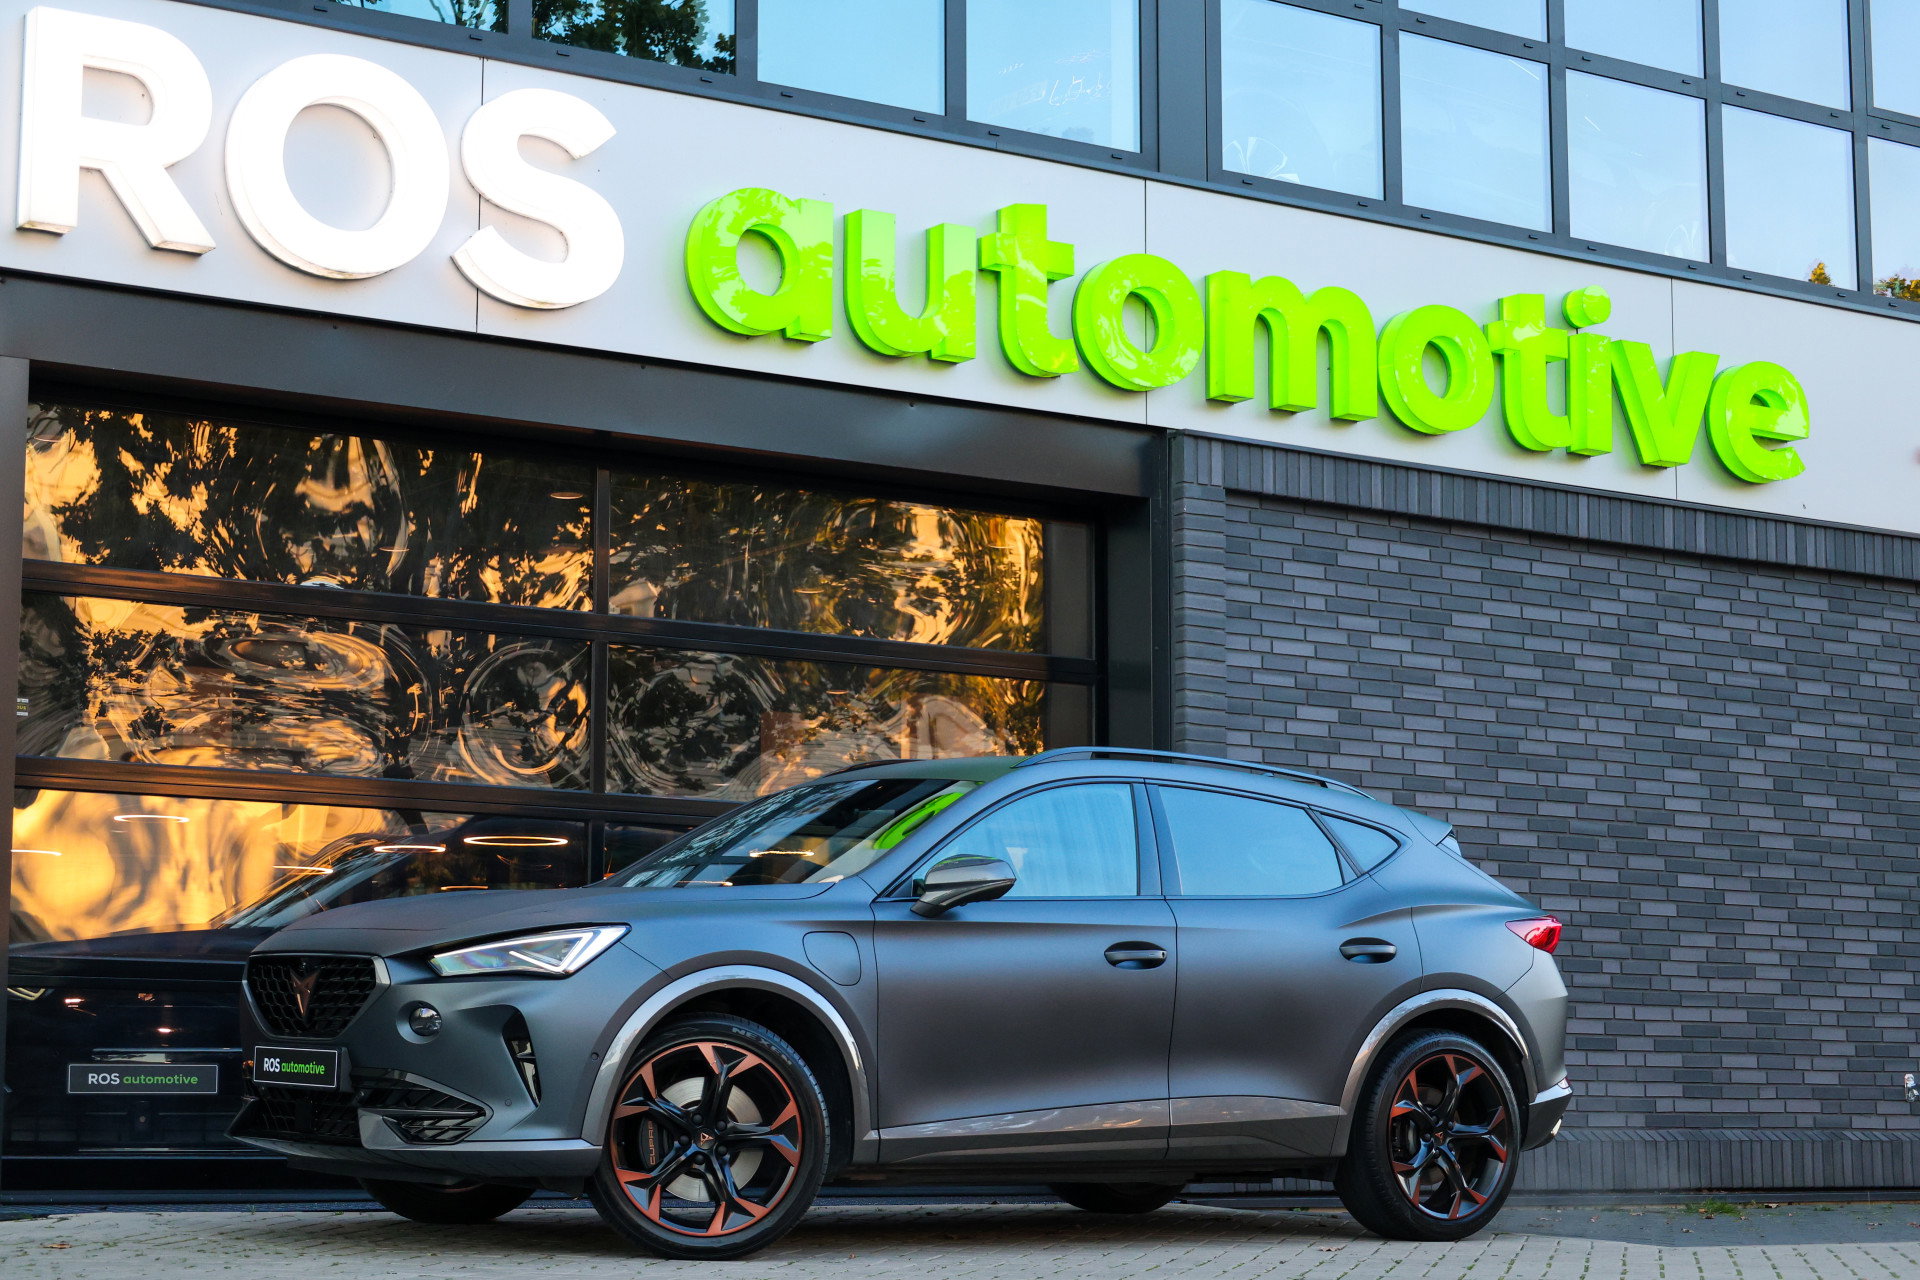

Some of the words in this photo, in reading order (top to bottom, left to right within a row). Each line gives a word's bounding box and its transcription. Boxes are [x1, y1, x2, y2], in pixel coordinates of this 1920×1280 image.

[17, 6, 625, 311] ROS
[684, 187, 1810, 484] automotive
[262, 1057, 281, 1073] ROS
[281, 1060, 326, 1075] automotive
[88, 1072, 120, 1085] ROS
[122, 1073, 199, 1085] automotive
